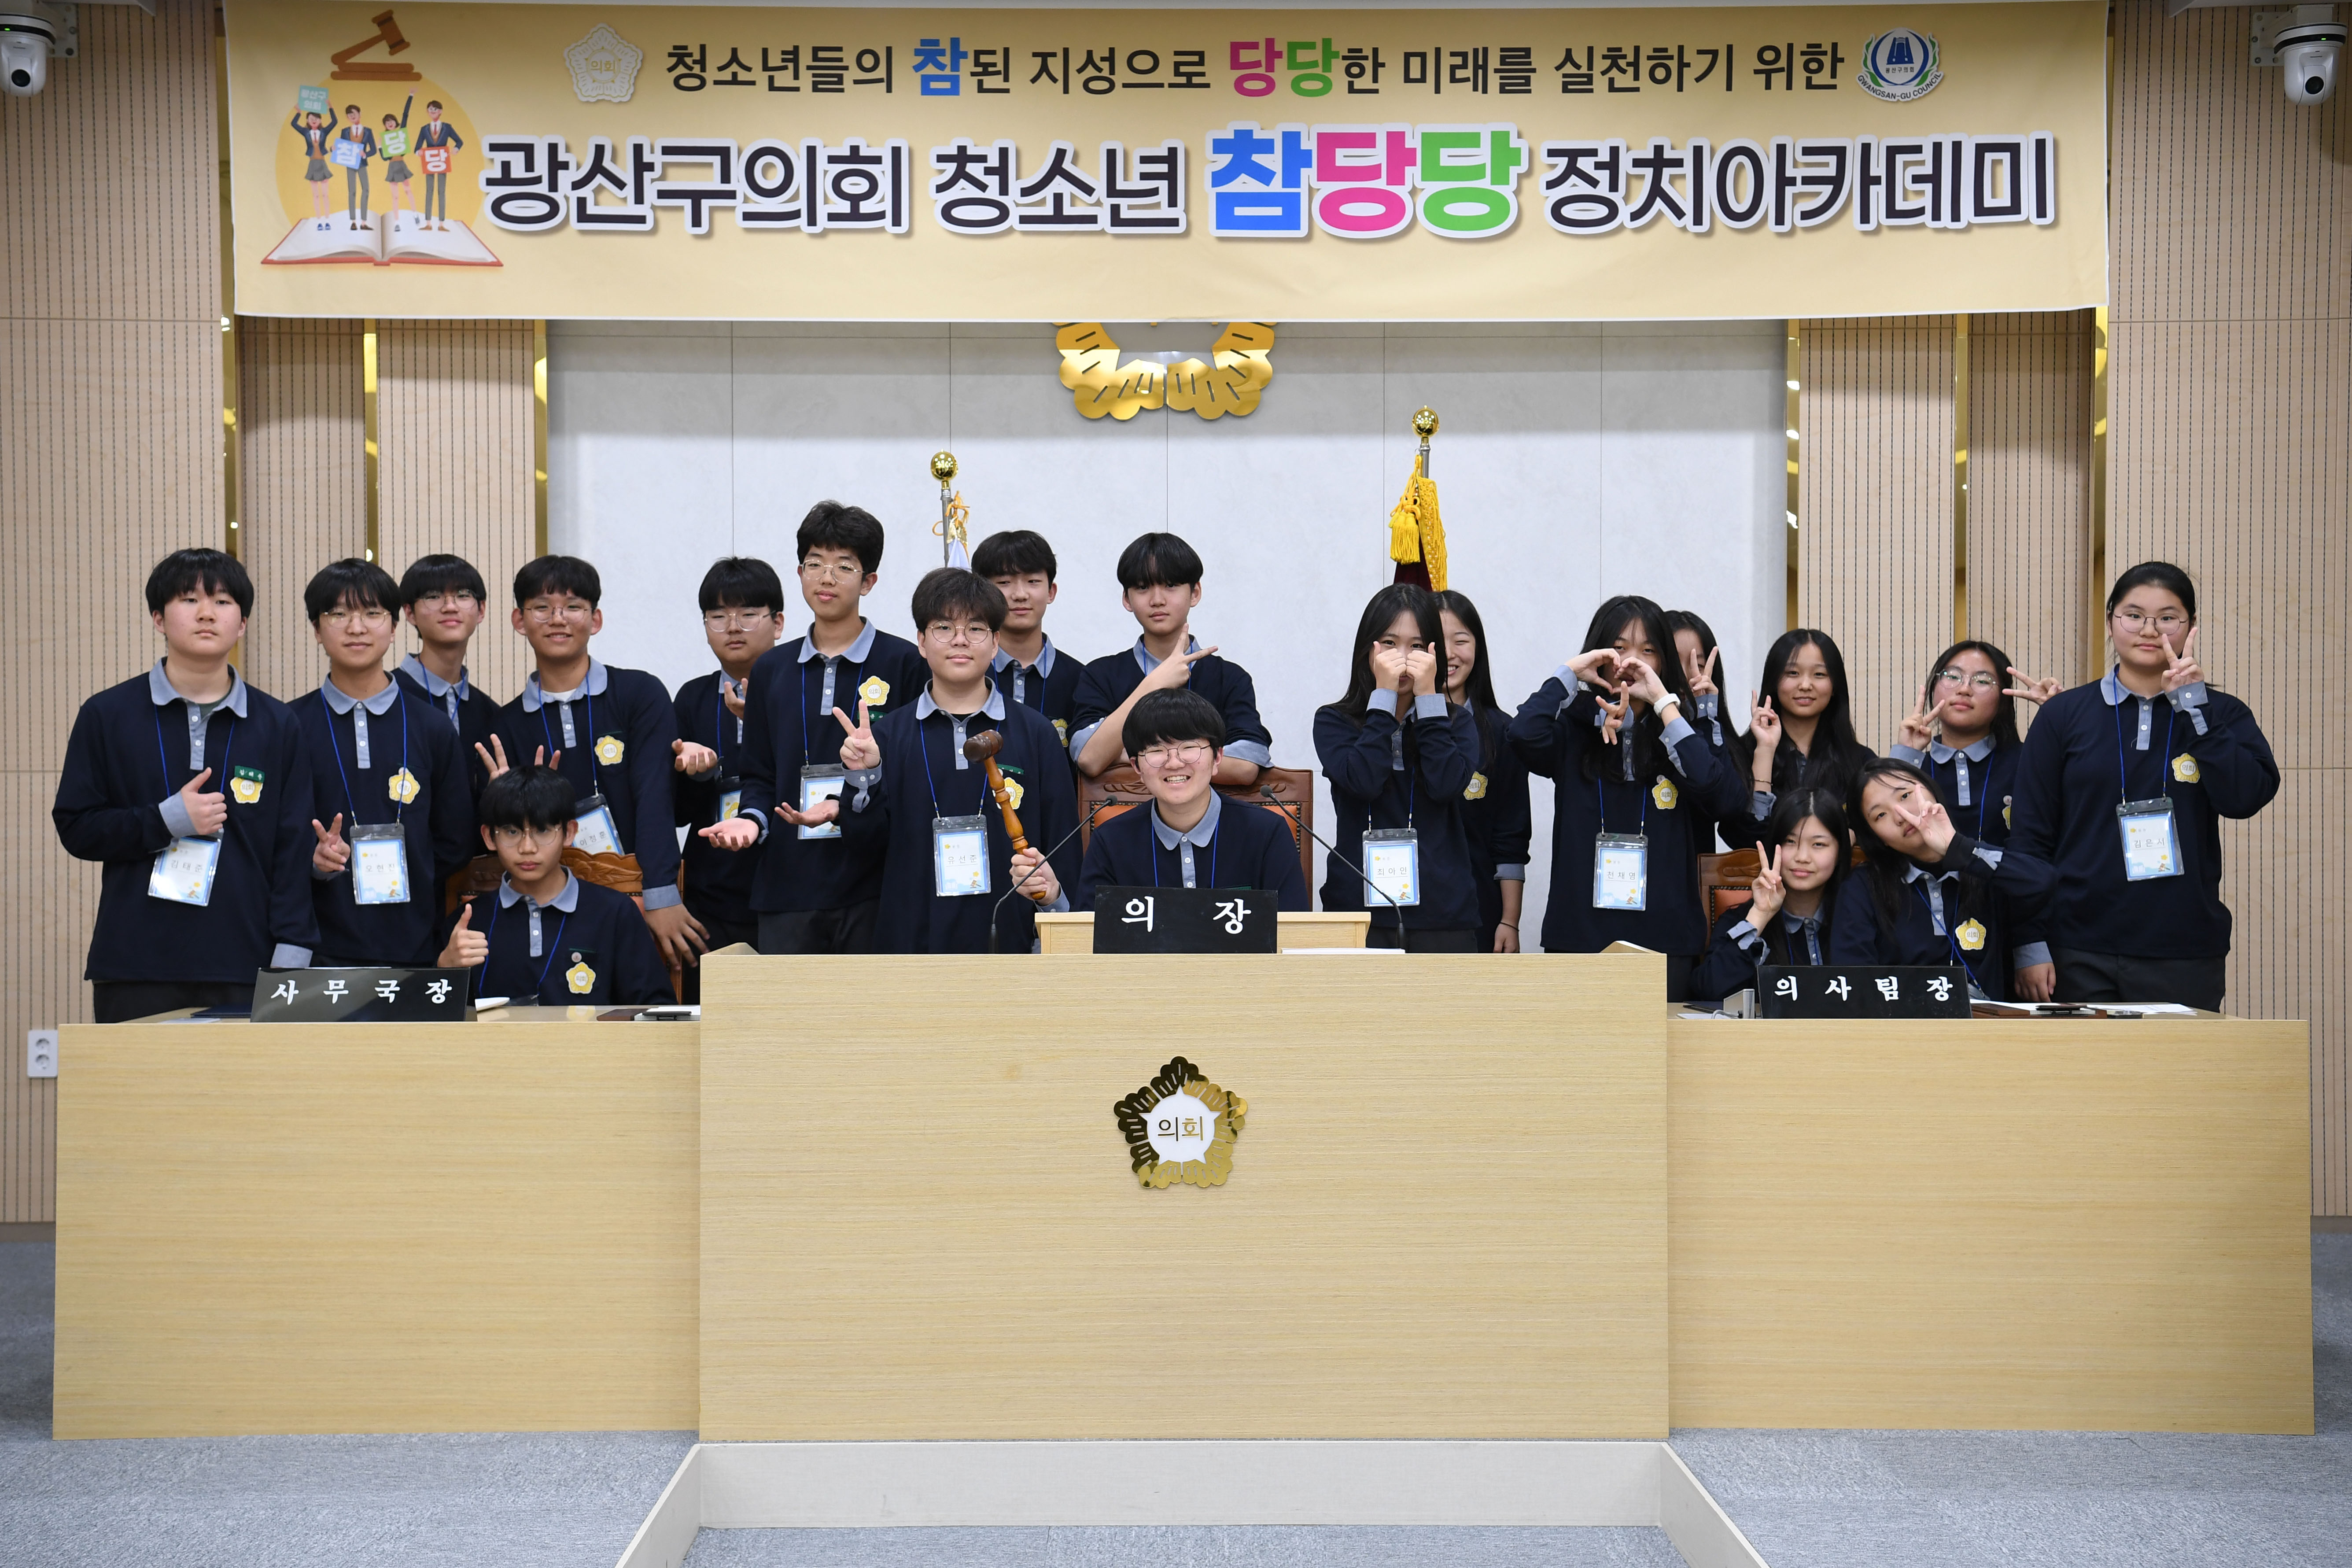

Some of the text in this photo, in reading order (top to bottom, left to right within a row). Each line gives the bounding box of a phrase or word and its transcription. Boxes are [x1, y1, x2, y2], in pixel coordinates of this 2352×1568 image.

[590, 59, 616, 74] 의회
[667, 37, 1845, 97] 청소년들의 참된 지성으로 당당한 미래를 실천하기 위한
[1858, 72, 1942, 100] GWANGSAN-GU COUNCIL
[337, 142, 360, 165] 참
[384, 129, 406, 154] 당
[424, 149, 448, 172] 당
[486, 129, 2048, 232] 광산구의회 청소년 참당당 정치아카데미
[1158, 1116, 1204, 1142] 의회
